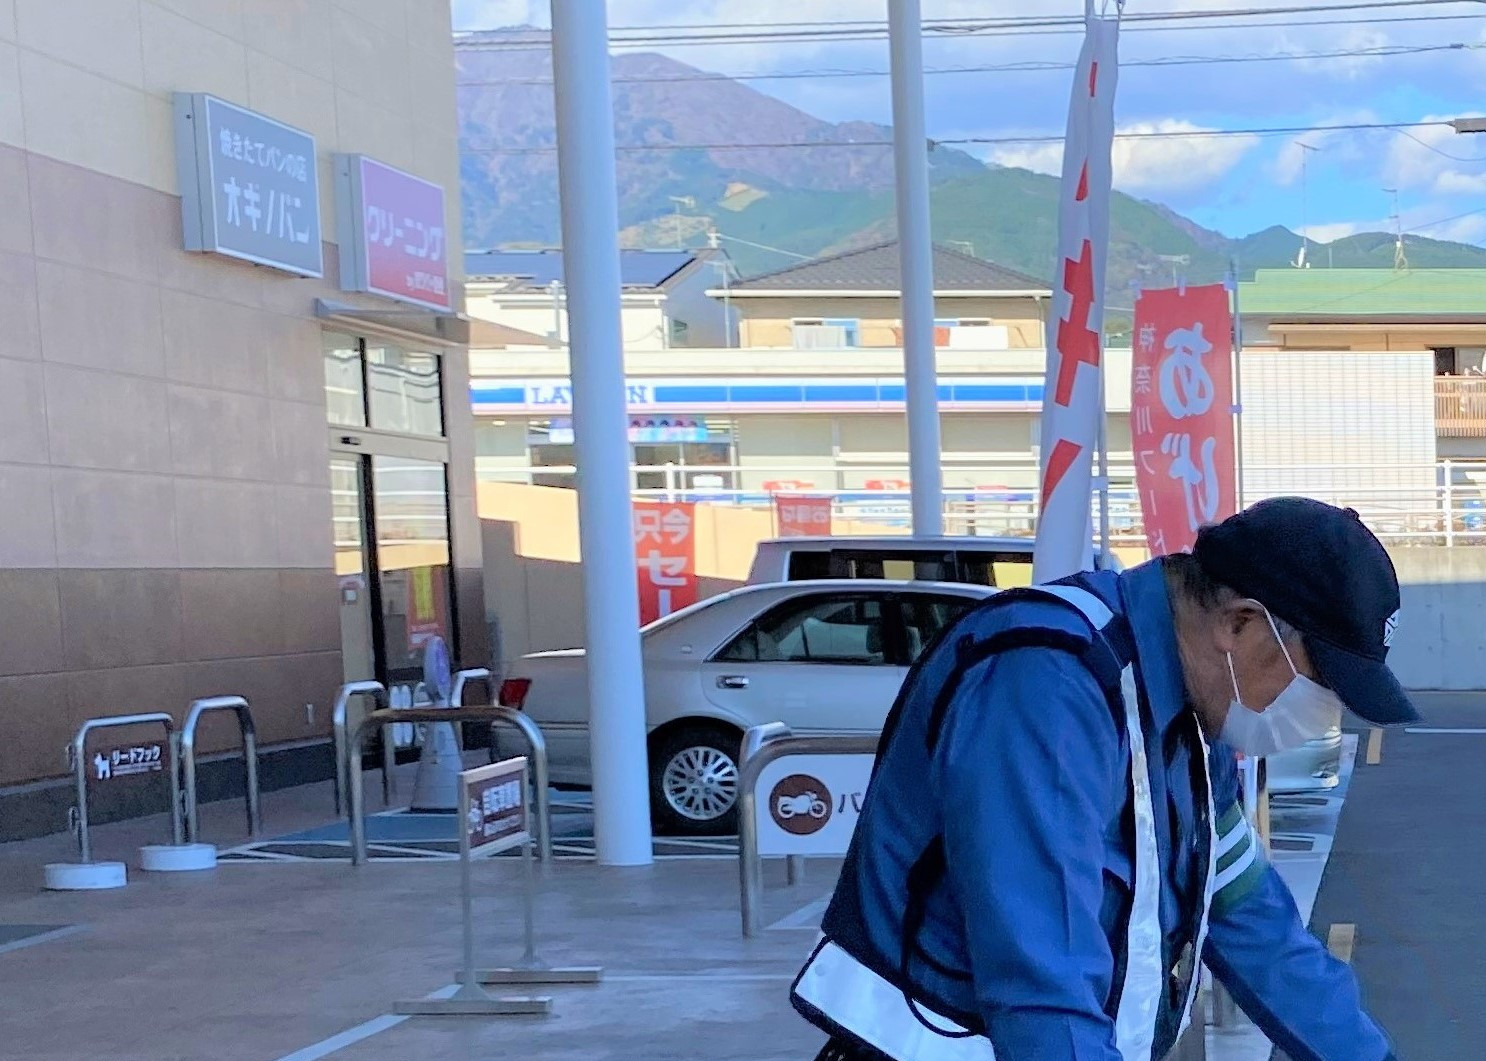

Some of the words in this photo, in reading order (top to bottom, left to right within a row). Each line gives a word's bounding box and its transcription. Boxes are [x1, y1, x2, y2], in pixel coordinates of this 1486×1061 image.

[367, 205, 443, 261] クリーニング
[531, 386, 647, 404] LAN
[634, 508, 691, 544] 只今
